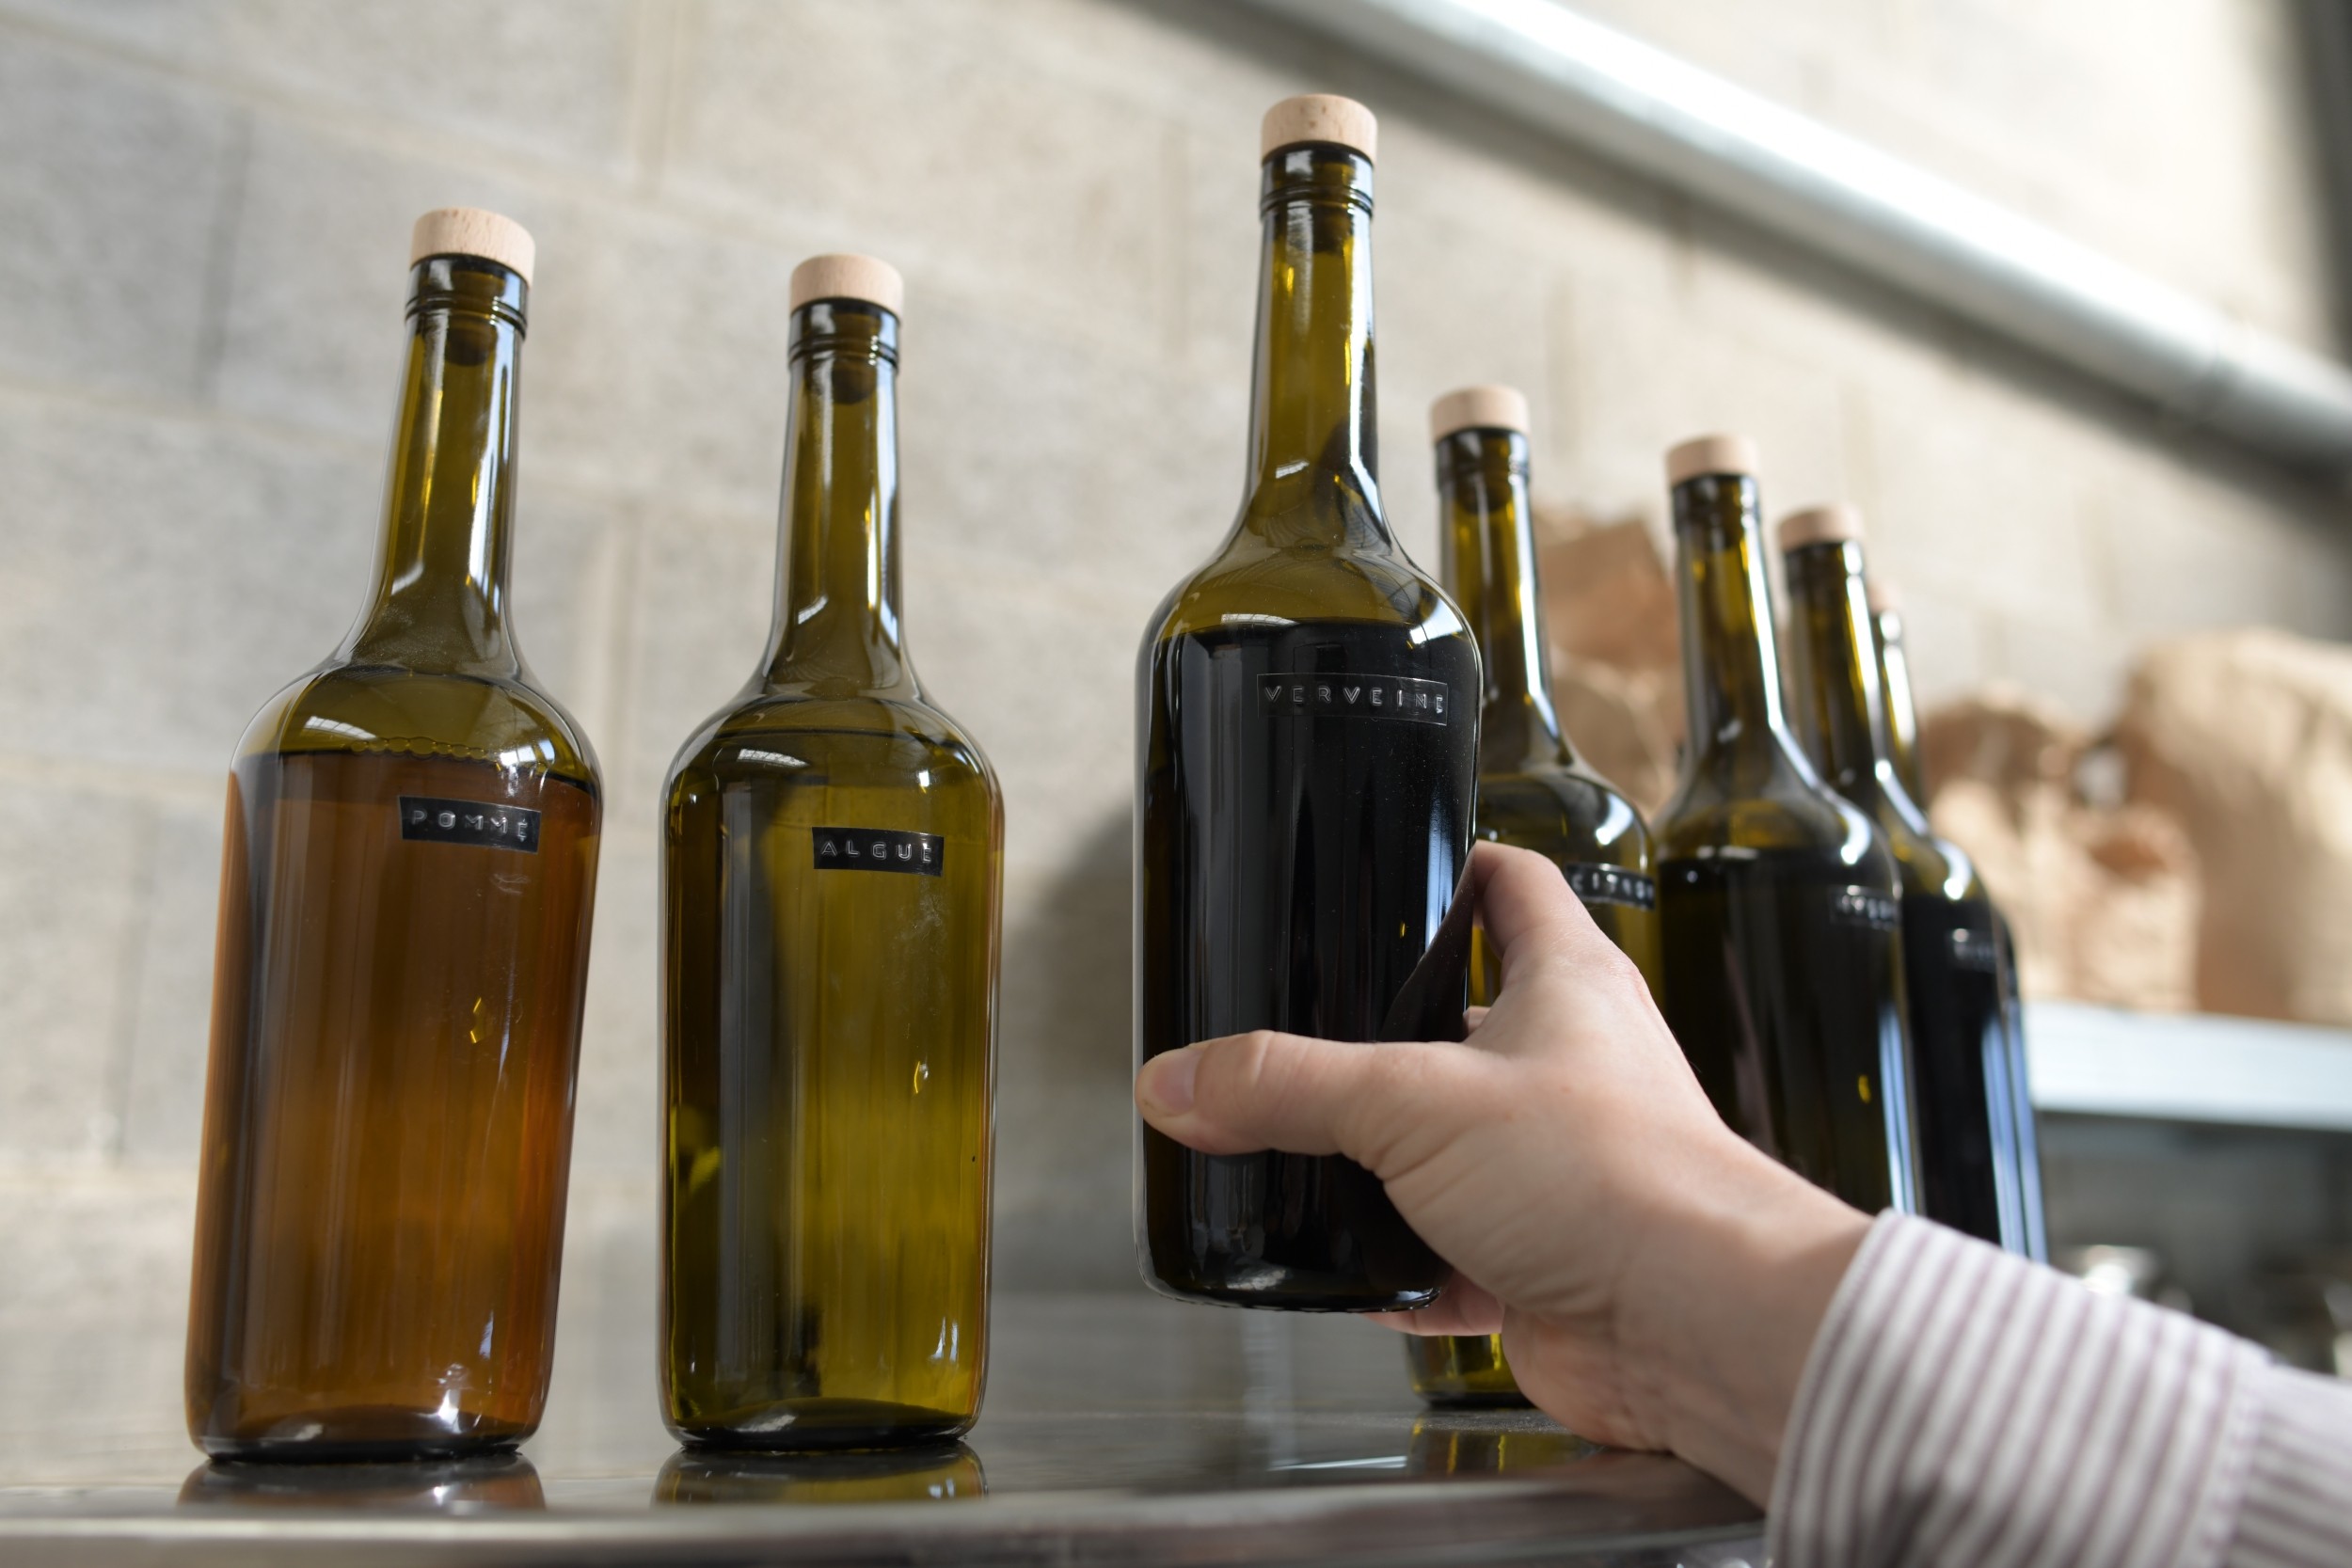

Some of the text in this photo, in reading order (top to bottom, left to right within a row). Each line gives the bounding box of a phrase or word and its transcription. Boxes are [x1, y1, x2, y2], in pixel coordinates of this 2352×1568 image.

[1264, 686, 1444, 714] VERVEINE
[411, 810, 529, 841] POMME
[819, 840, 933, 863] ALGUE
